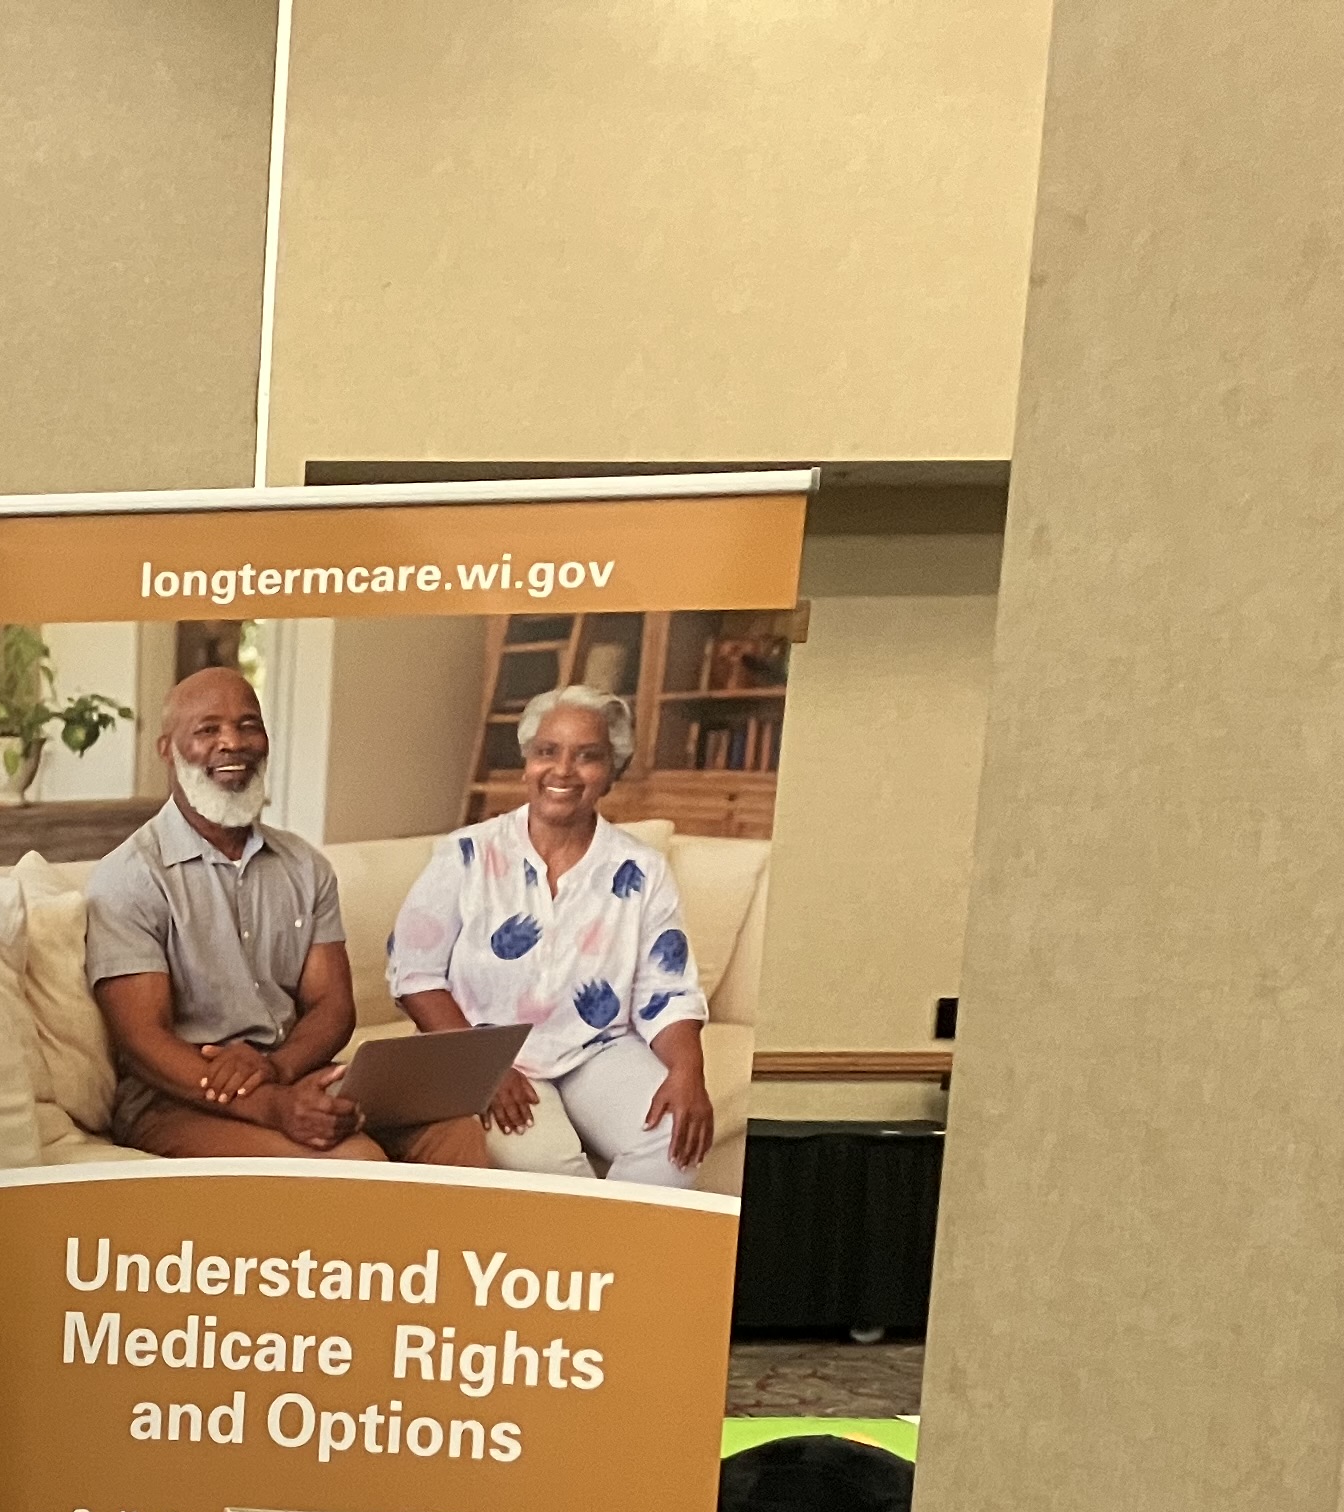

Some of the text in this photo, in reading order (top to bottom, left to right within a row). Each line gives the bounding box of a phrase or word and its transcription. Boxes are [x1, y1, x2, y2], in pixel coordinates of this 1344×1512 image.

[140, 554, 615, 606] longtermcare.wi.gov
[64, 1237, 613, 1312] Understand Your
[62, 1311, 605, 1397] Medicare Rights
[129, 1392, 522, 1464] and Options
